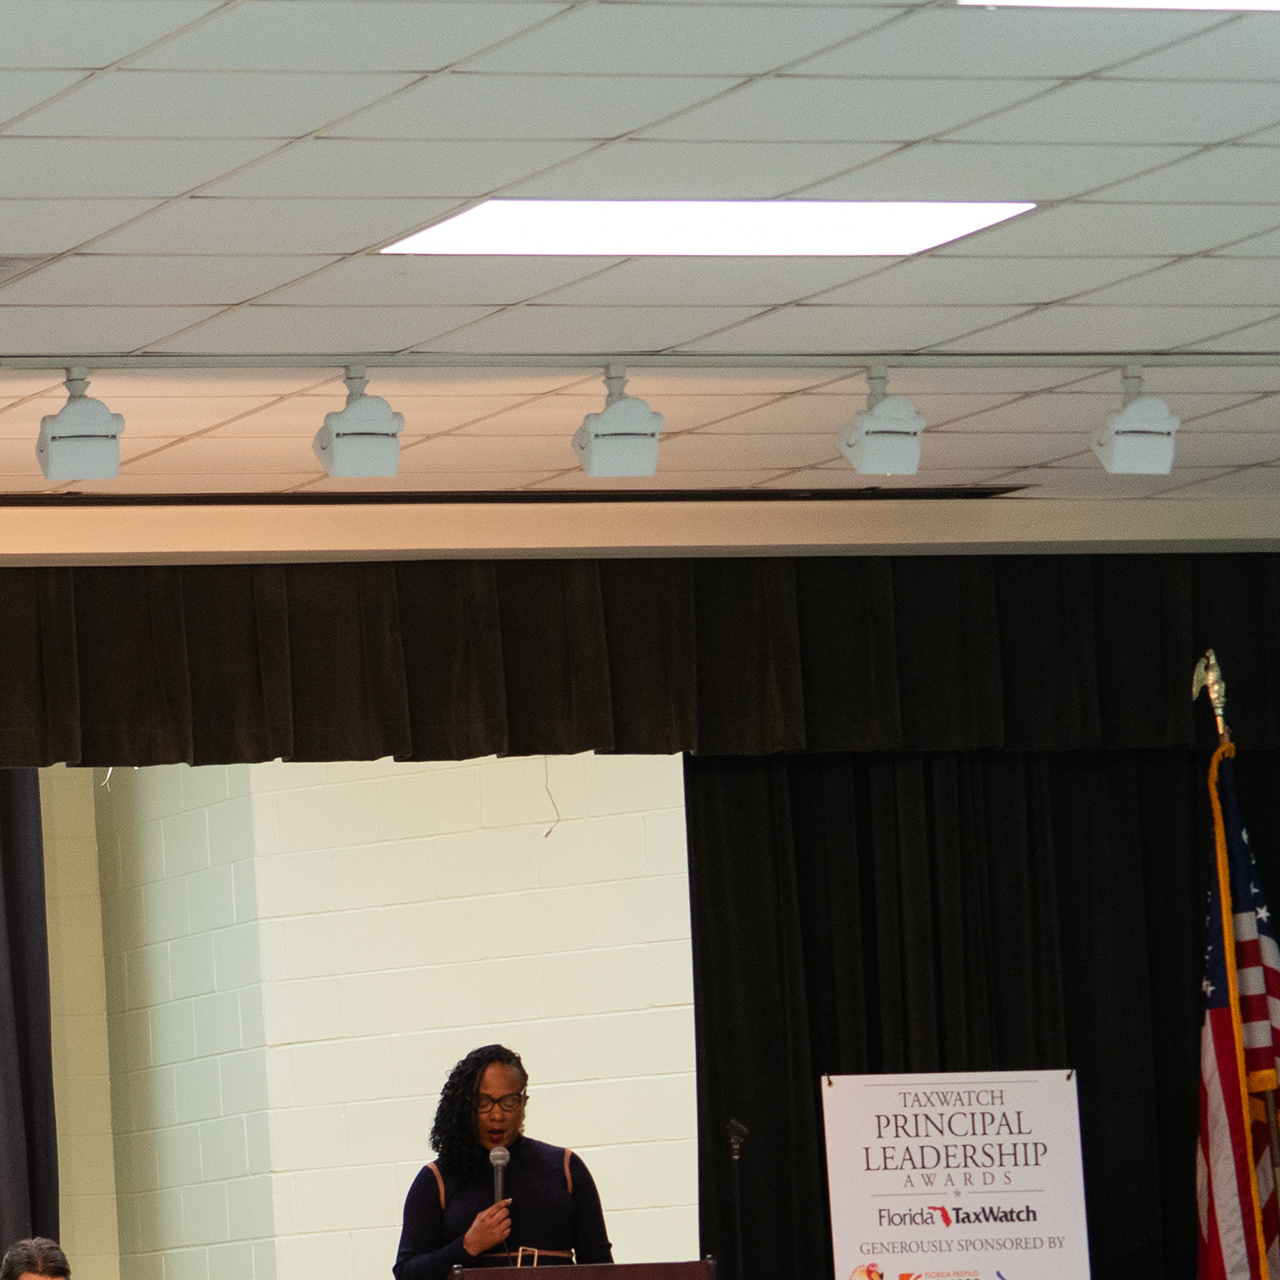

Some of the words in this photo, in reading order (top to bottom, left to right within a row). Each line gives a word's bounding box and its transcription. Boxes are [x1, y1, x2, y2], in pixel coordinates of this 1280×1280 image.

[899, 1090, 1005, 1108] TAXWATCH
[876, 1111, 1032, 1139] PRINCIPAL
[863, 1142, 1048, 1171] LEADERSHIP
[878, 1208, 935, 1226] Florida
[952, 1206, 1037, 1224] TaxWatch
[860, 1239, 954, 1255] GENEROUSLY
[958, 1237, 1044, 1252] SPONSORED
[1047, 1236, 1066, 1250] BY
